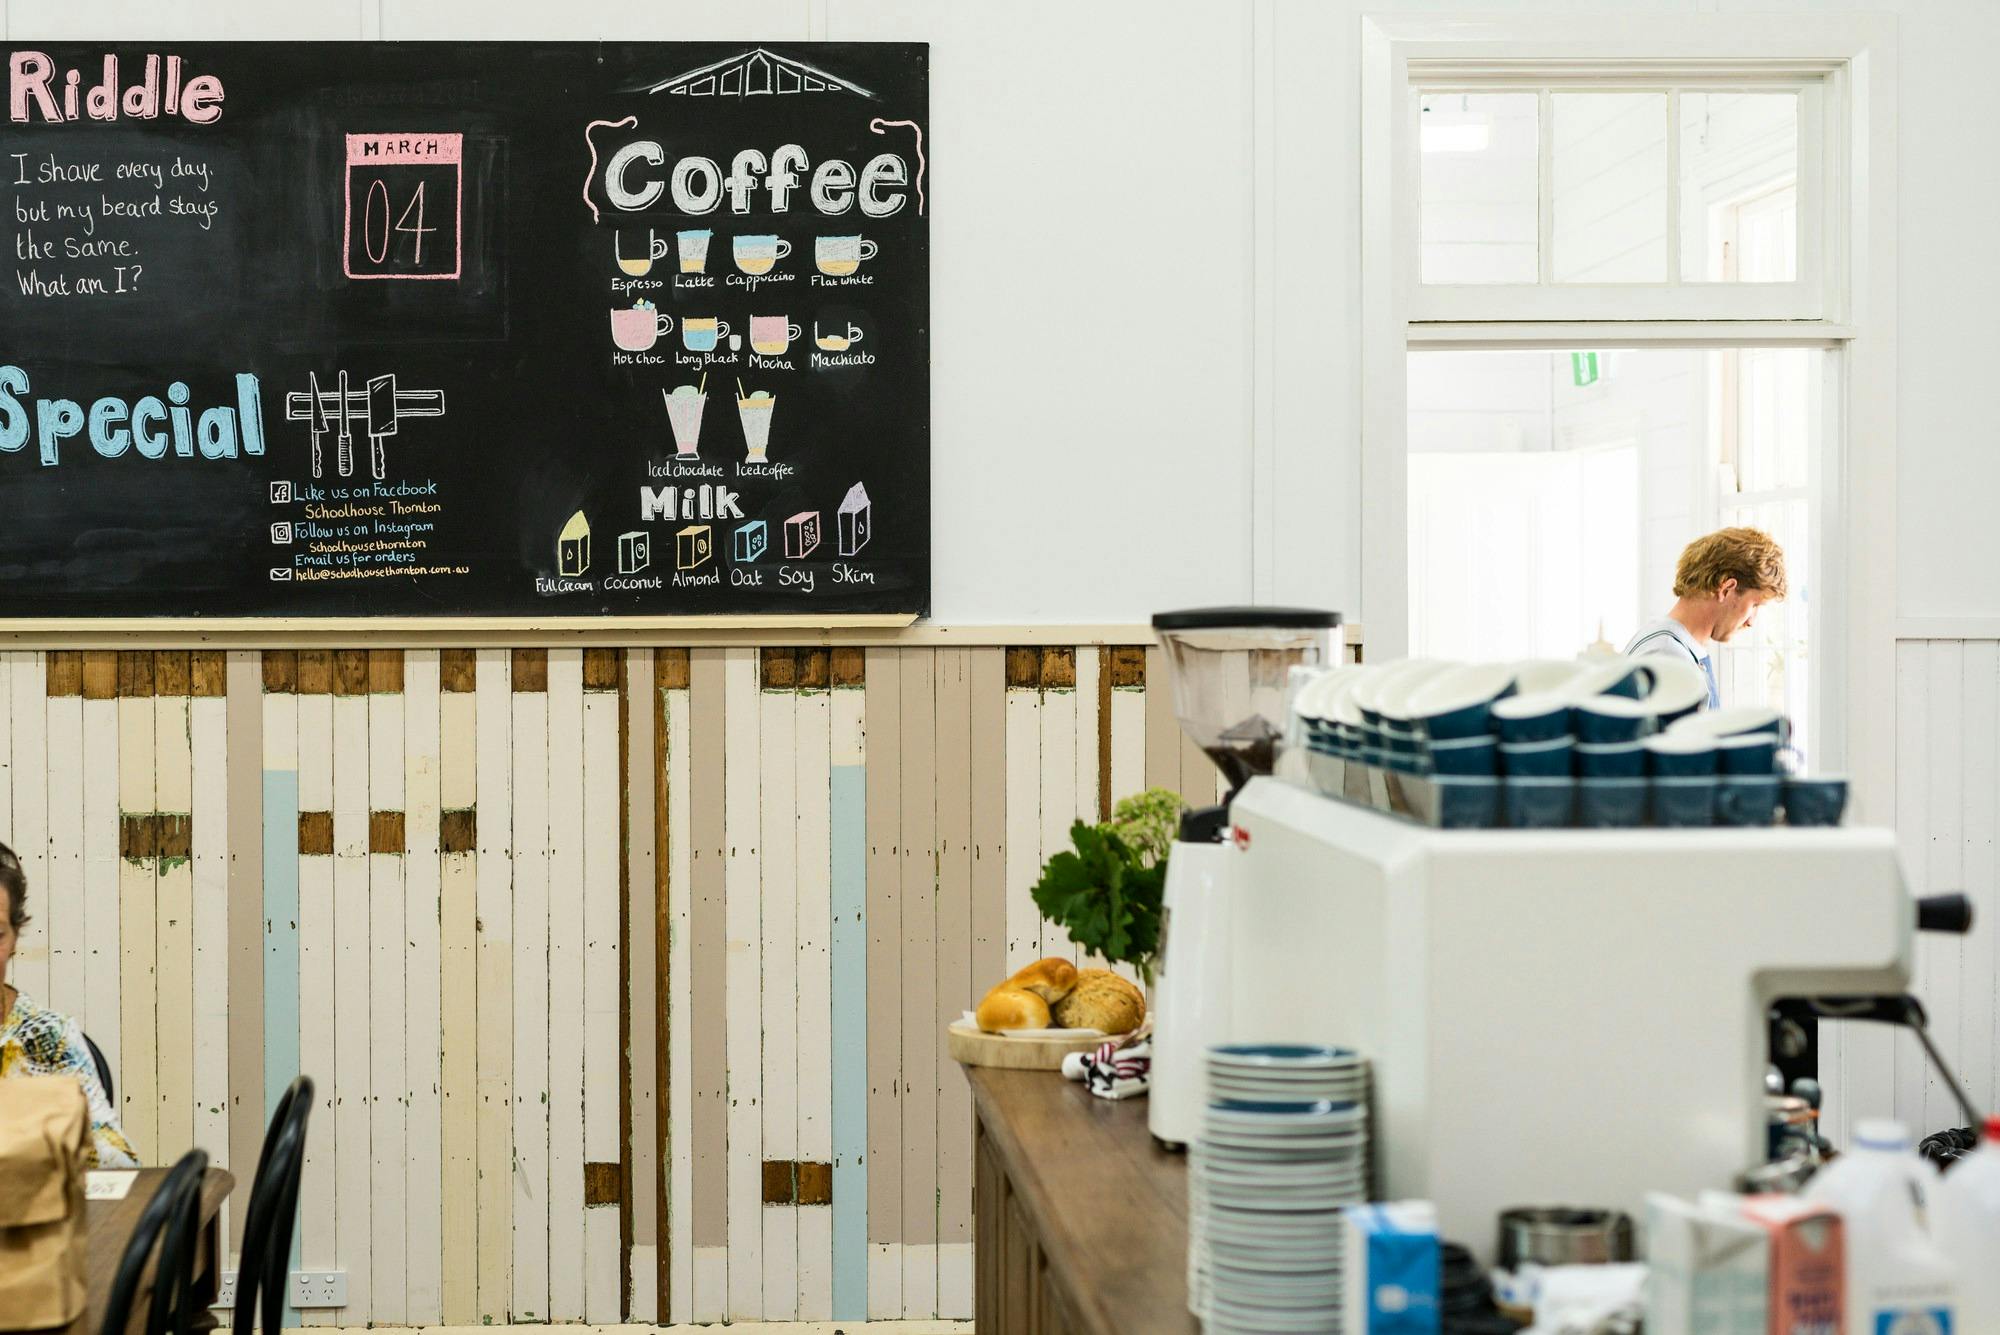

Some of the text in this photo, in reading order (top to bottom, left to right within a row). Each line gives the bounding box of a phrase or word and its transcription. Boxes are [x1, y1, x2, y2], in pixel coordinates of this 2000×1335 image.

[9, 51, 225, 124] Riddle
[364, 139, 438, 156] MARCH
[11, 153, 32, 185] I
[37, 153, 104, 184] shave
[116, 161, 163, 190] every
[605, 140, 908, 218] Coffee
[15, 194, 219, 236] but my beard stays
[365, 179, 437, 264] 04
[16, 228, 56, 260] the
[16, 265, 143, 298] What am I?
[611, 277, 663, 297] Espresso
[674, 274, 715, 288] Latte
[725, 271, 796, 292] Cappuccino
[811, 275, 838, 287] Flat
[613, 351, 634, 365] Hot
[675, 352, 739, 371] Long Black
[749, 354, 795, 371] Mocha
[811, 350, 876, 367] Macchiato
[0, 365, 265, 466] Special
[648, 460, 672, 477] Iced
[736, 461, 795, 480] Iced coffee
[294, 479, 437, 501] Like us on Facebook
[305, 500, 441, 520] Schoolhouse Thornton
[640, 483, 745, 521] Milk
[294, 519, 434, 539] Follow us on Instagram
[295, 550, 416, 567] Email us for orders
[604, 576, 663, 590] Coconut
[672, 570, 720, 587] Almond
[730, 567, 763, 586] Oat
[778, 565, 815, 593] Soy
[832, 563, 875, 584] Skim
[535, 577, 593, 592] Full Cream
